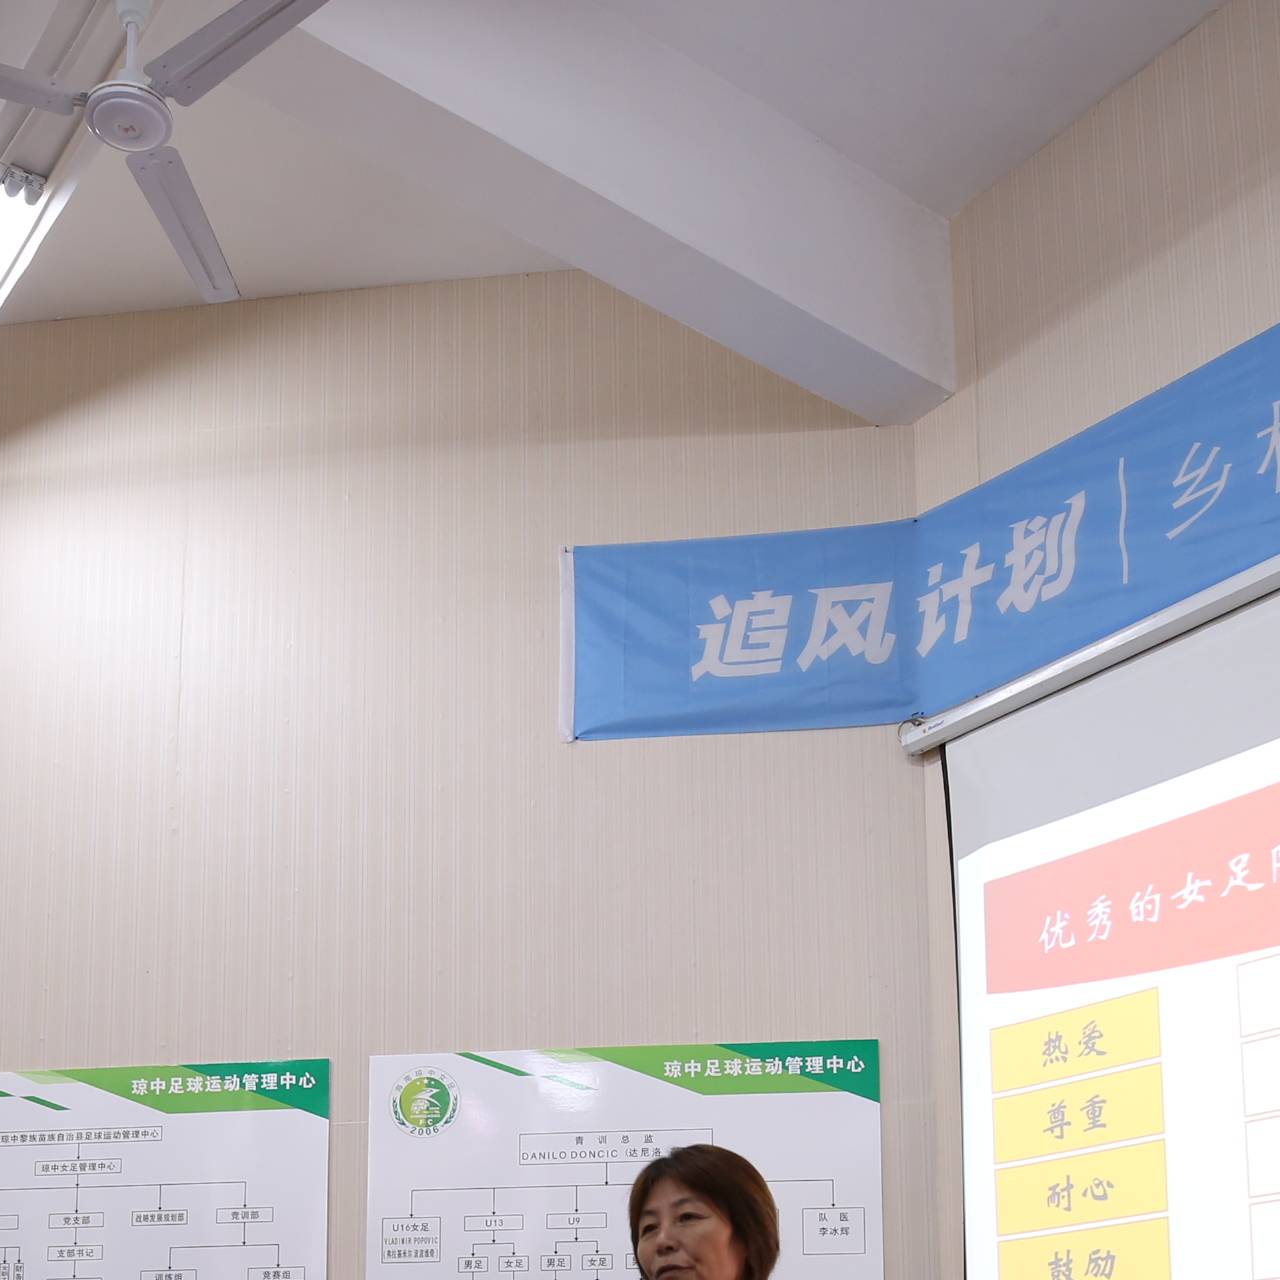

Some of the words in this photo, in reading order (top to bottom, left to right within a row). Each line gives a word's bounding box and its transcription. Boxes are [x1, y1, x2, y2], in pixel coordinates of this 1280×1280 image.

[692, 490, 1086, 682] 追风计划
[1042, 1019, 1108, 1067] 热爱
[664, 1055, 866, 1078] 琼中足球运动管理中心
[131, 1071, 317, 1096] 琼中足球运动管理中心
[1043, 1094, 1108, 1140] 尊重
[0, 1128, 160, 1144] 琼中黎族苗族自治县足球运动管理中心
[409, 1126, 440, 1136] 2006
[521, 1150, 567, 1161] DANILO
[570, 1149, 618, 1160] DONCIC
[41, 1160, 116, 1173] 琼中女足管理中心
[1046, 1175, 1115, 1213] 耐心
[63, 1214, 91, 1226] 党支部
[231, 1210, 260, 1220] 竞训部
[818, 1212, 849, 1223] 队医
[392, 1222, 430, 1232] U16女足
[485, 1218, 504, 1228] U13
[568, 1217, 581, 1226] U9
[818, 1226, 850, 1236] 李冰辉
[56, 1248, 94, 1258] 支部书记
[463, 1259, 483, 1270] 男足
[504, 1259, 524, 1269] 女足
[546, 1258, 566, 1268] 男足
[588, 1257, 607, 1267] 女足
[262, 1269, 291, 1280] 竞赛组
